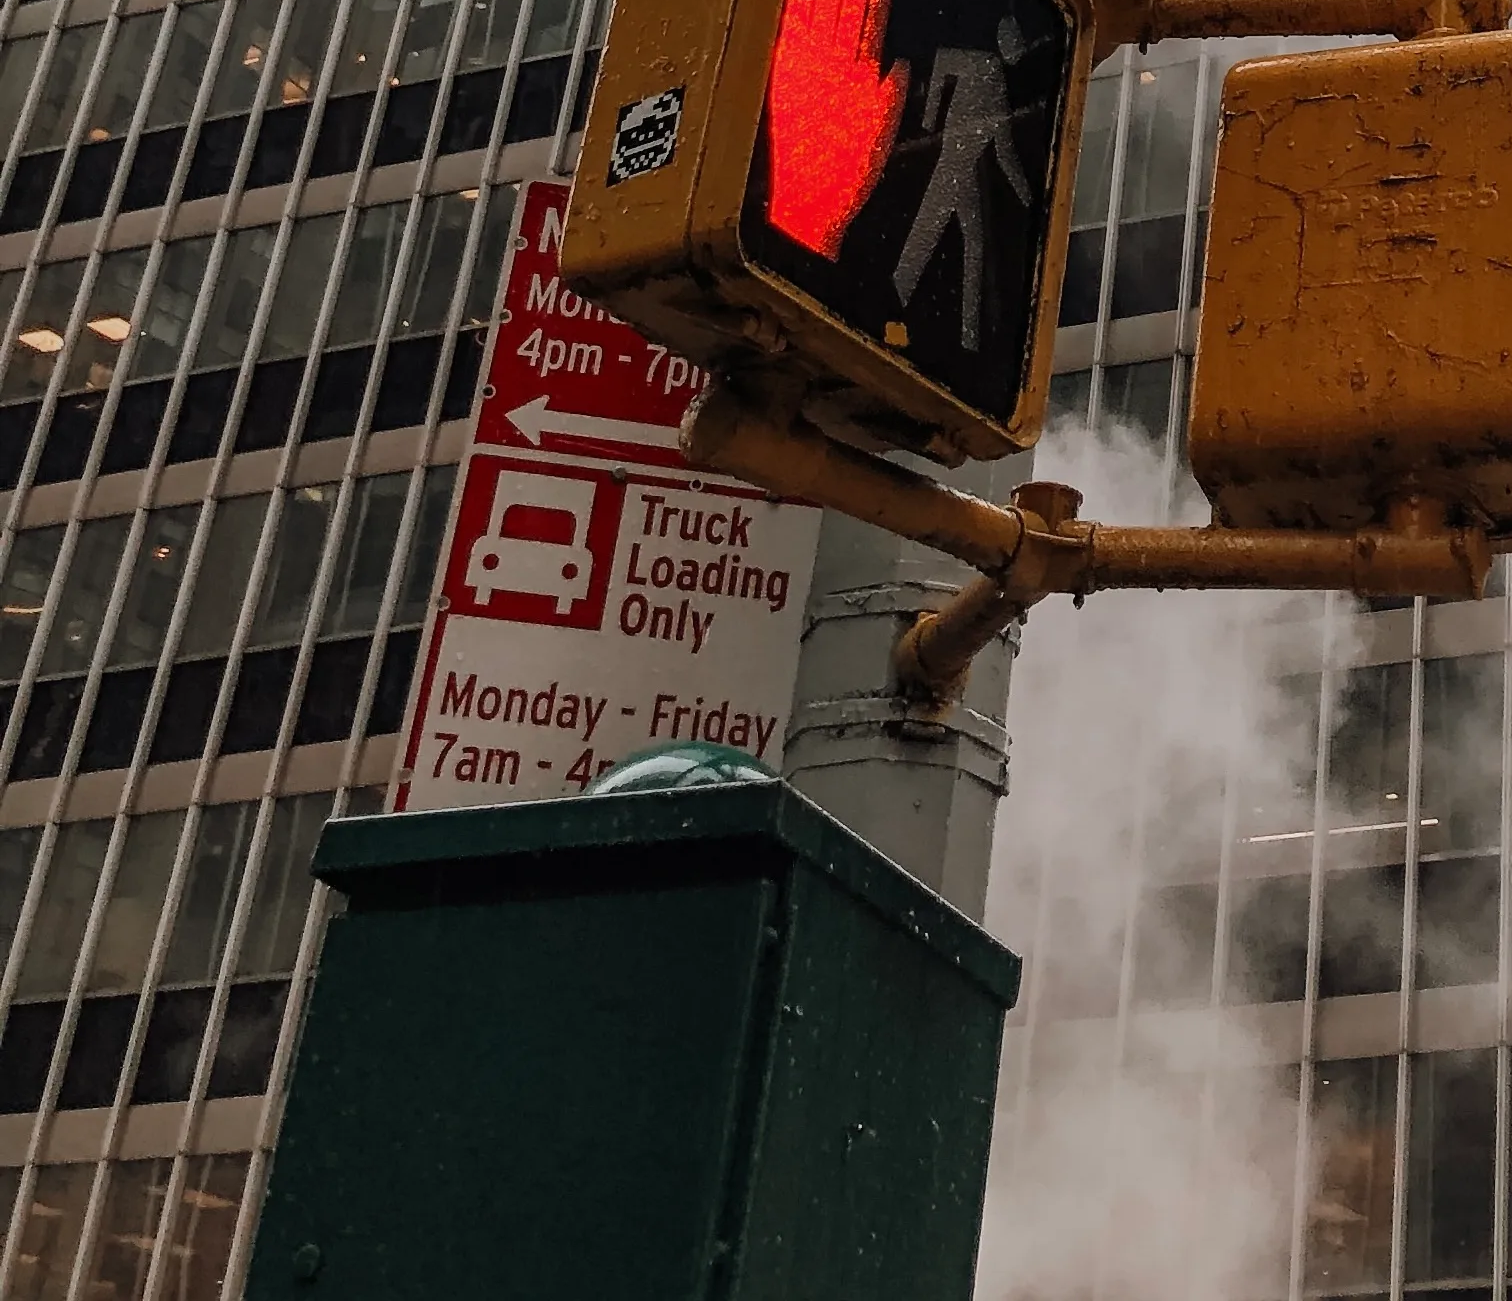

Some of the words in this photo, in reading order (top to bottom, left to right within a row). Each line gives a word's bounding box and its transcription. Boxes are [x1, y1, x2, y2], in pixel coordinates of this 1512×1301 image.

[516, 328, 603, 378] 4pm
[640, 493, 753, 549] Truck
[626, 542, 791, 612] Loading
[619, 593, 716, 654] Only
[439, 670, 609, 742] Monday
[648, 693, 778, 759] Friday
[431, 731, 521, 786] 7am
